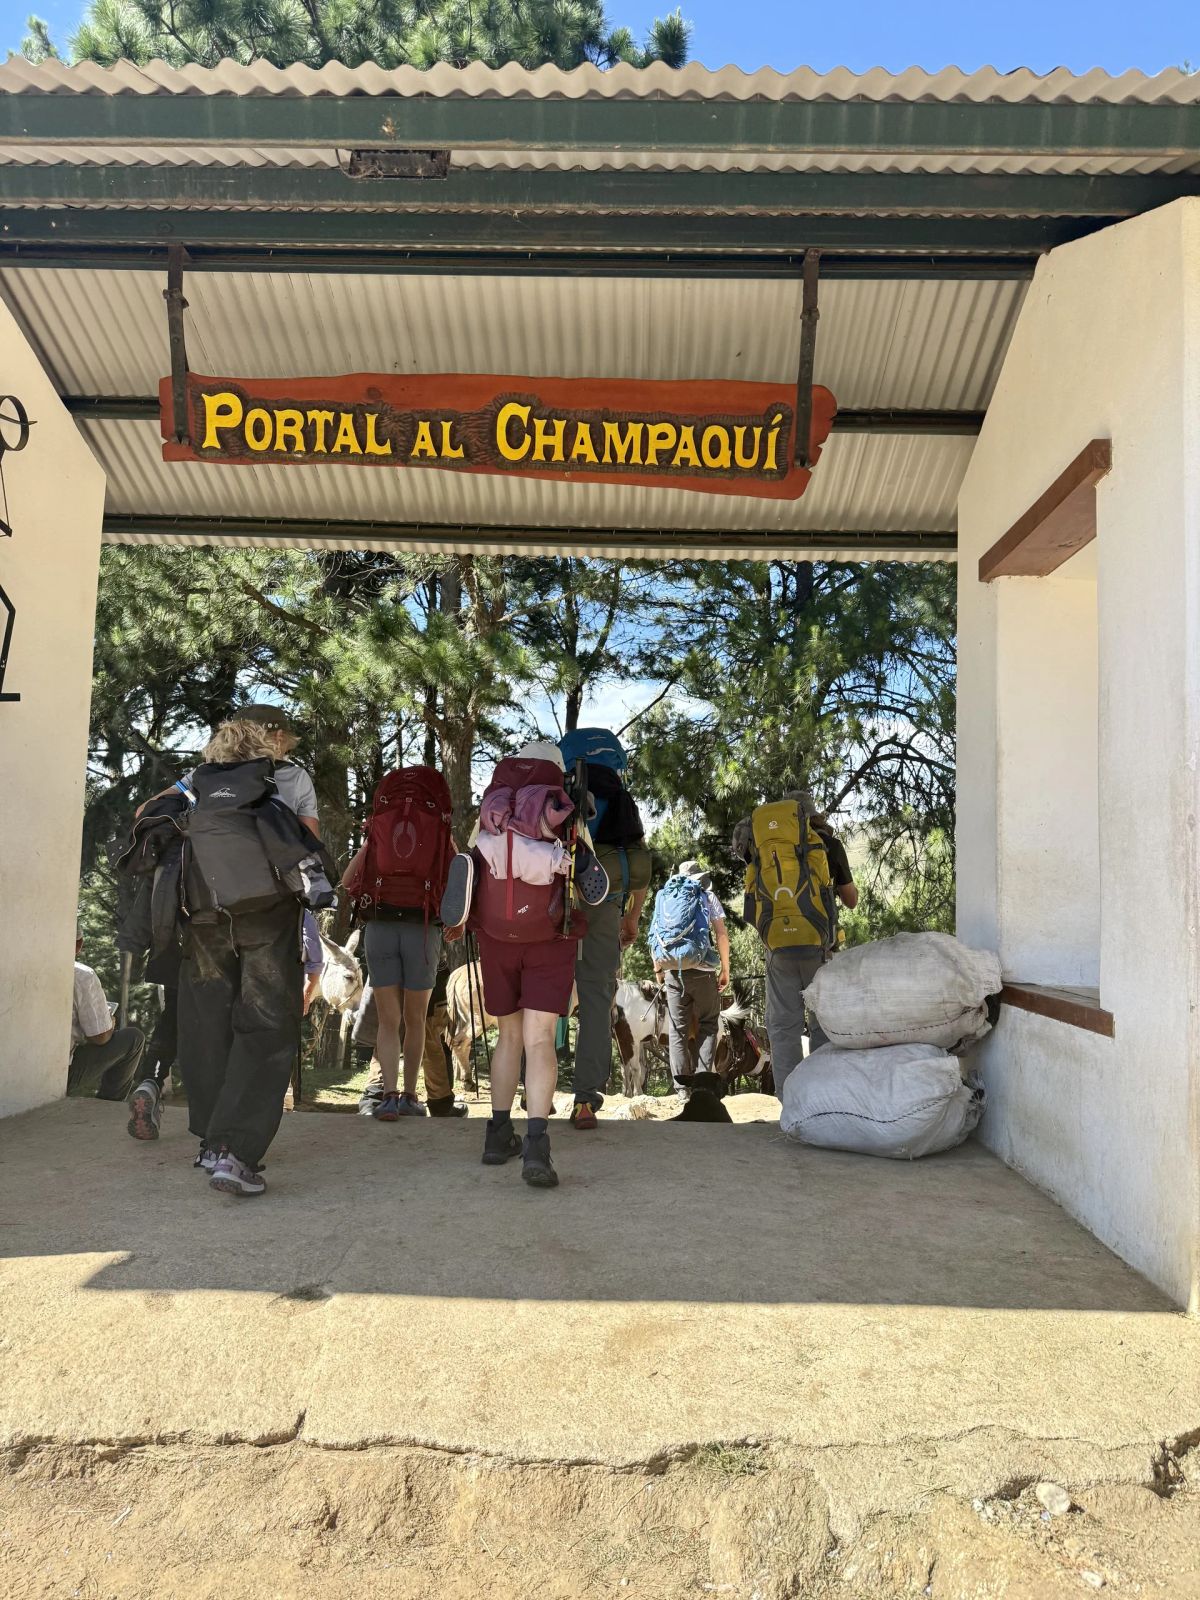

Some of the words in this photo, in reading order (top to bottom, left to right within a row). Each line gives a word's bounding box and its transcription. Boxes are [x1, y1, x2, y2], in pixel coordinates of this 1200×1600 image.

[202, 392, 392, 455] PORTAL
[411, 421, 465, 459] AL
[496, 402, 782, 470] CHAMPAQUÍ
